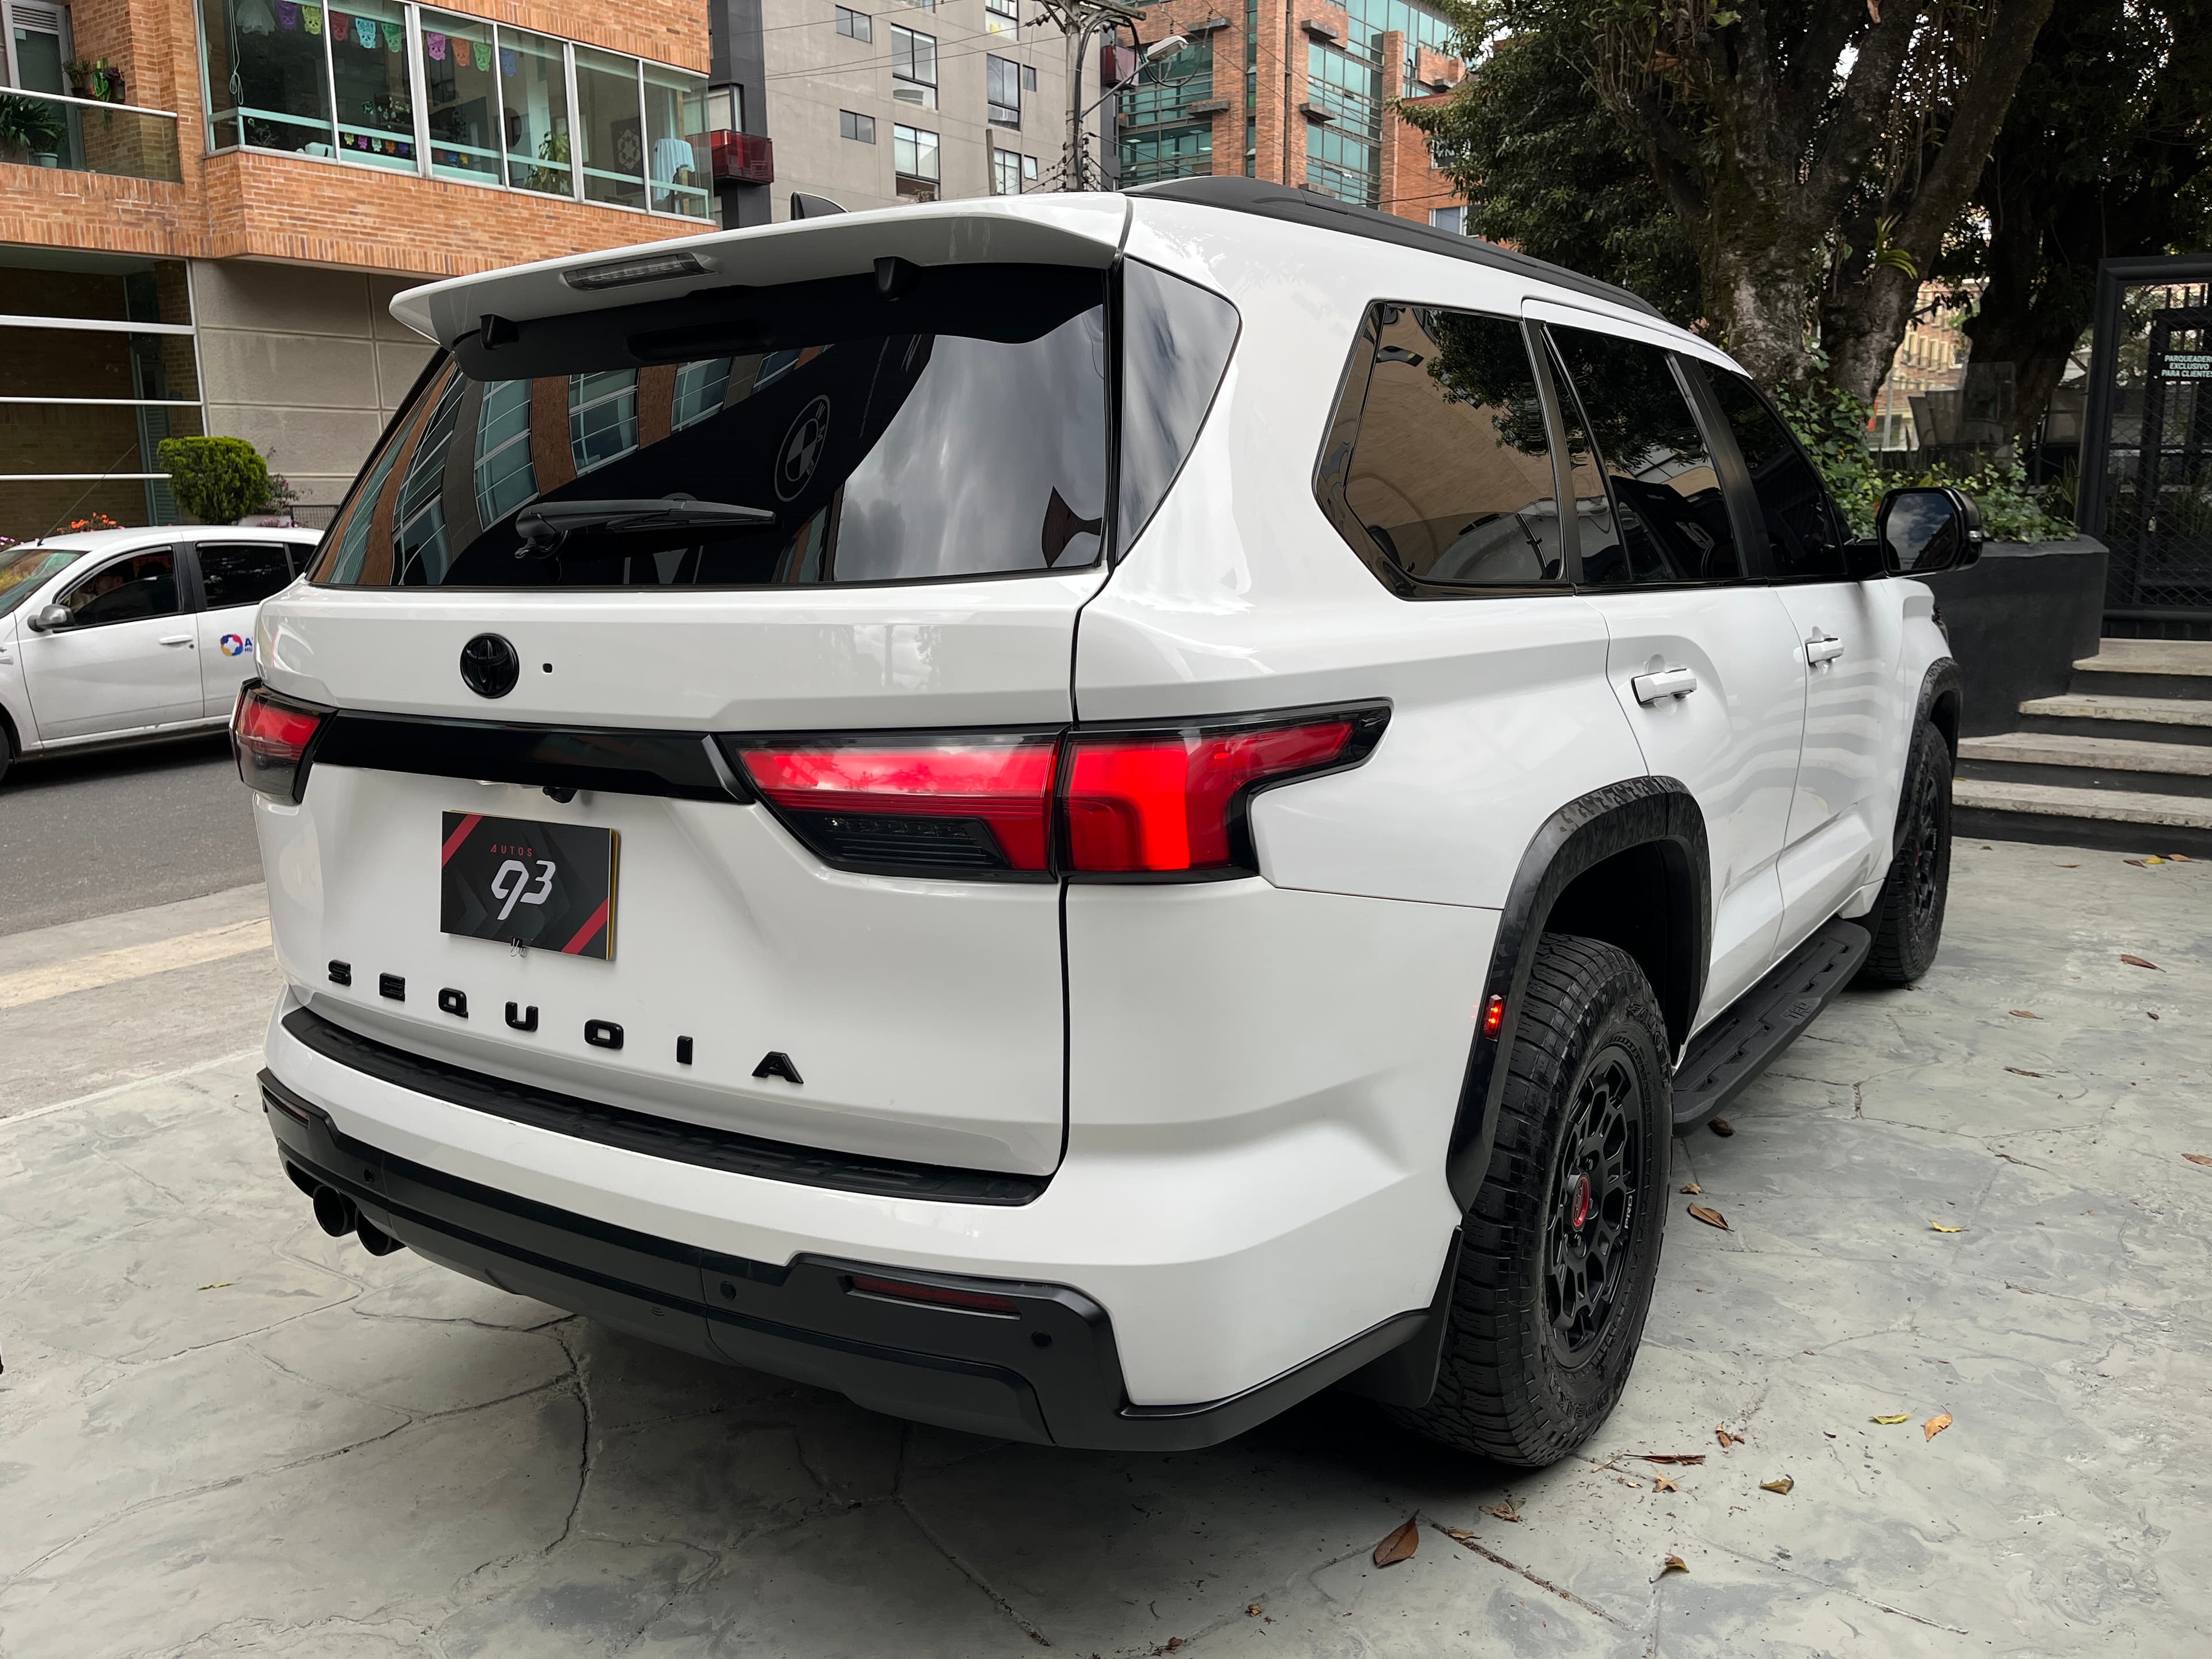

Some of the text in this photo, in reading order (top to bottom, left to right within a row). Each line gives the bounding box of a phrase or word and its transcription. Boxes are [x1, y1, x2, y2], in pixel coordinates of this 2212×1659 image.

[2161, 369, 2180, 377] PARA
[490, 844, 533, 857] AUTOS
[491, 859, 556, 921] 93
[328, 959, 804, 1084] SEQUOIA
[1624, 1195, 1633, 1229] PRO
